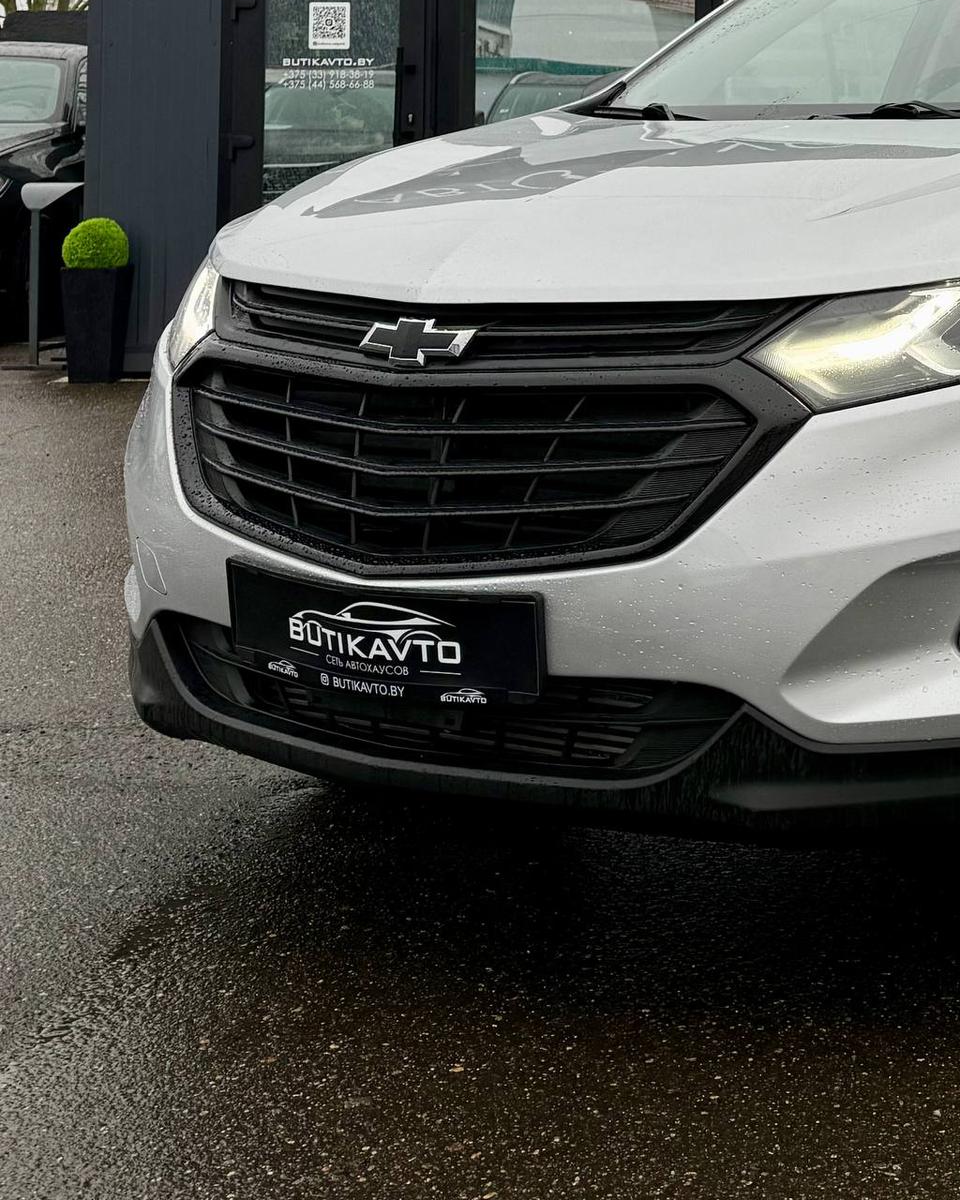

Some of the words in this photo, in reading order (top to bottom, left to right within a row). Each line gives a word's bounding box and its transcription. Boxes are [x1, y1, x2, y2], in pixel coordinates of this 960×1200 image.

[282, 57, 375, 67] BUTIKAVTO.BY
[283, 79, 306, 89] +375
[308, 79, 326, 91] (44)
[288, 616, 462, 665] BUTIKAVTO
[325, 654, 344, 667] СЕТЬ
[345, 658, 410, 676] АВТОХАУСОВ
[332, 676, 406, 698] BUTIKAVTO.BY
